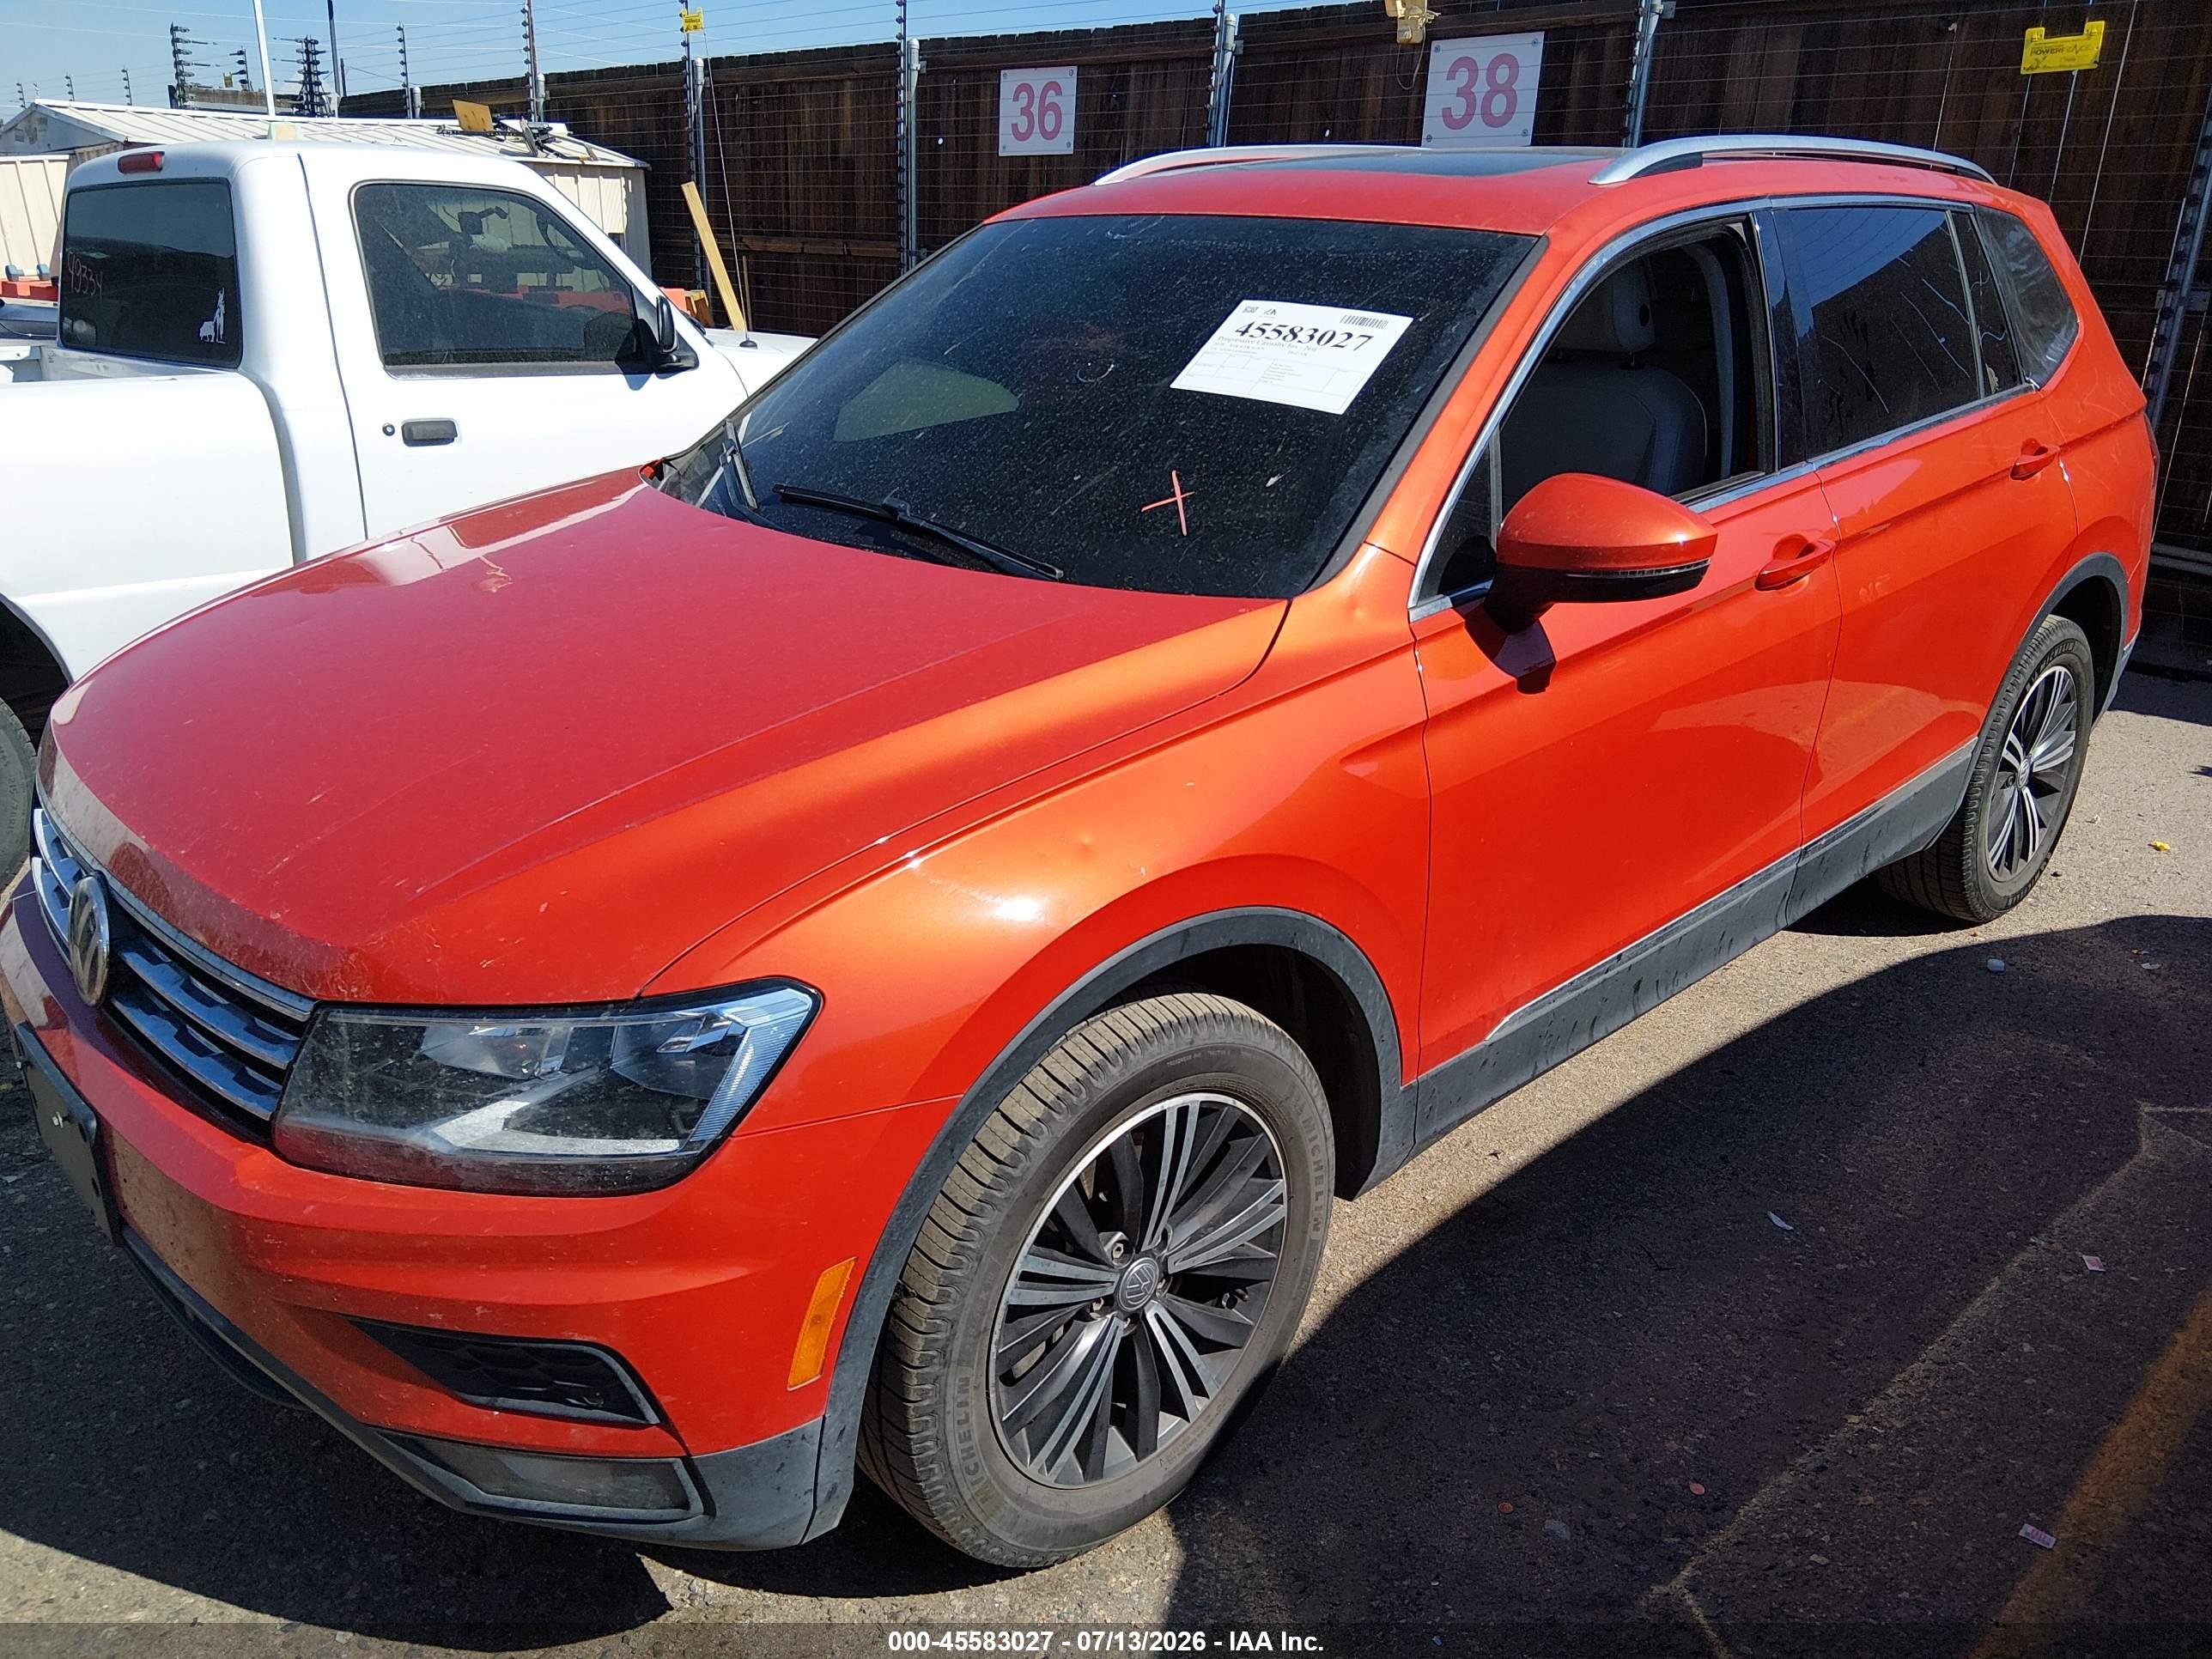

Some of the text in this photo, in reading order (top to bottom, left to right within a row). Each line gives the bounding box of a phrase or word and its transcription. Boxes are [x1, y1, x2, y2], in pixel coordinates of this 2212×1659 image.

[1011, 81, 1063, 142] 36
[1441, 52, 1520, 131] 38
[1235, 321, 1374, 351] 45583027
[1302, 1118, 1324, 1231] MICHELIN
[956, 1376, 996, 1505] MICHELIN
